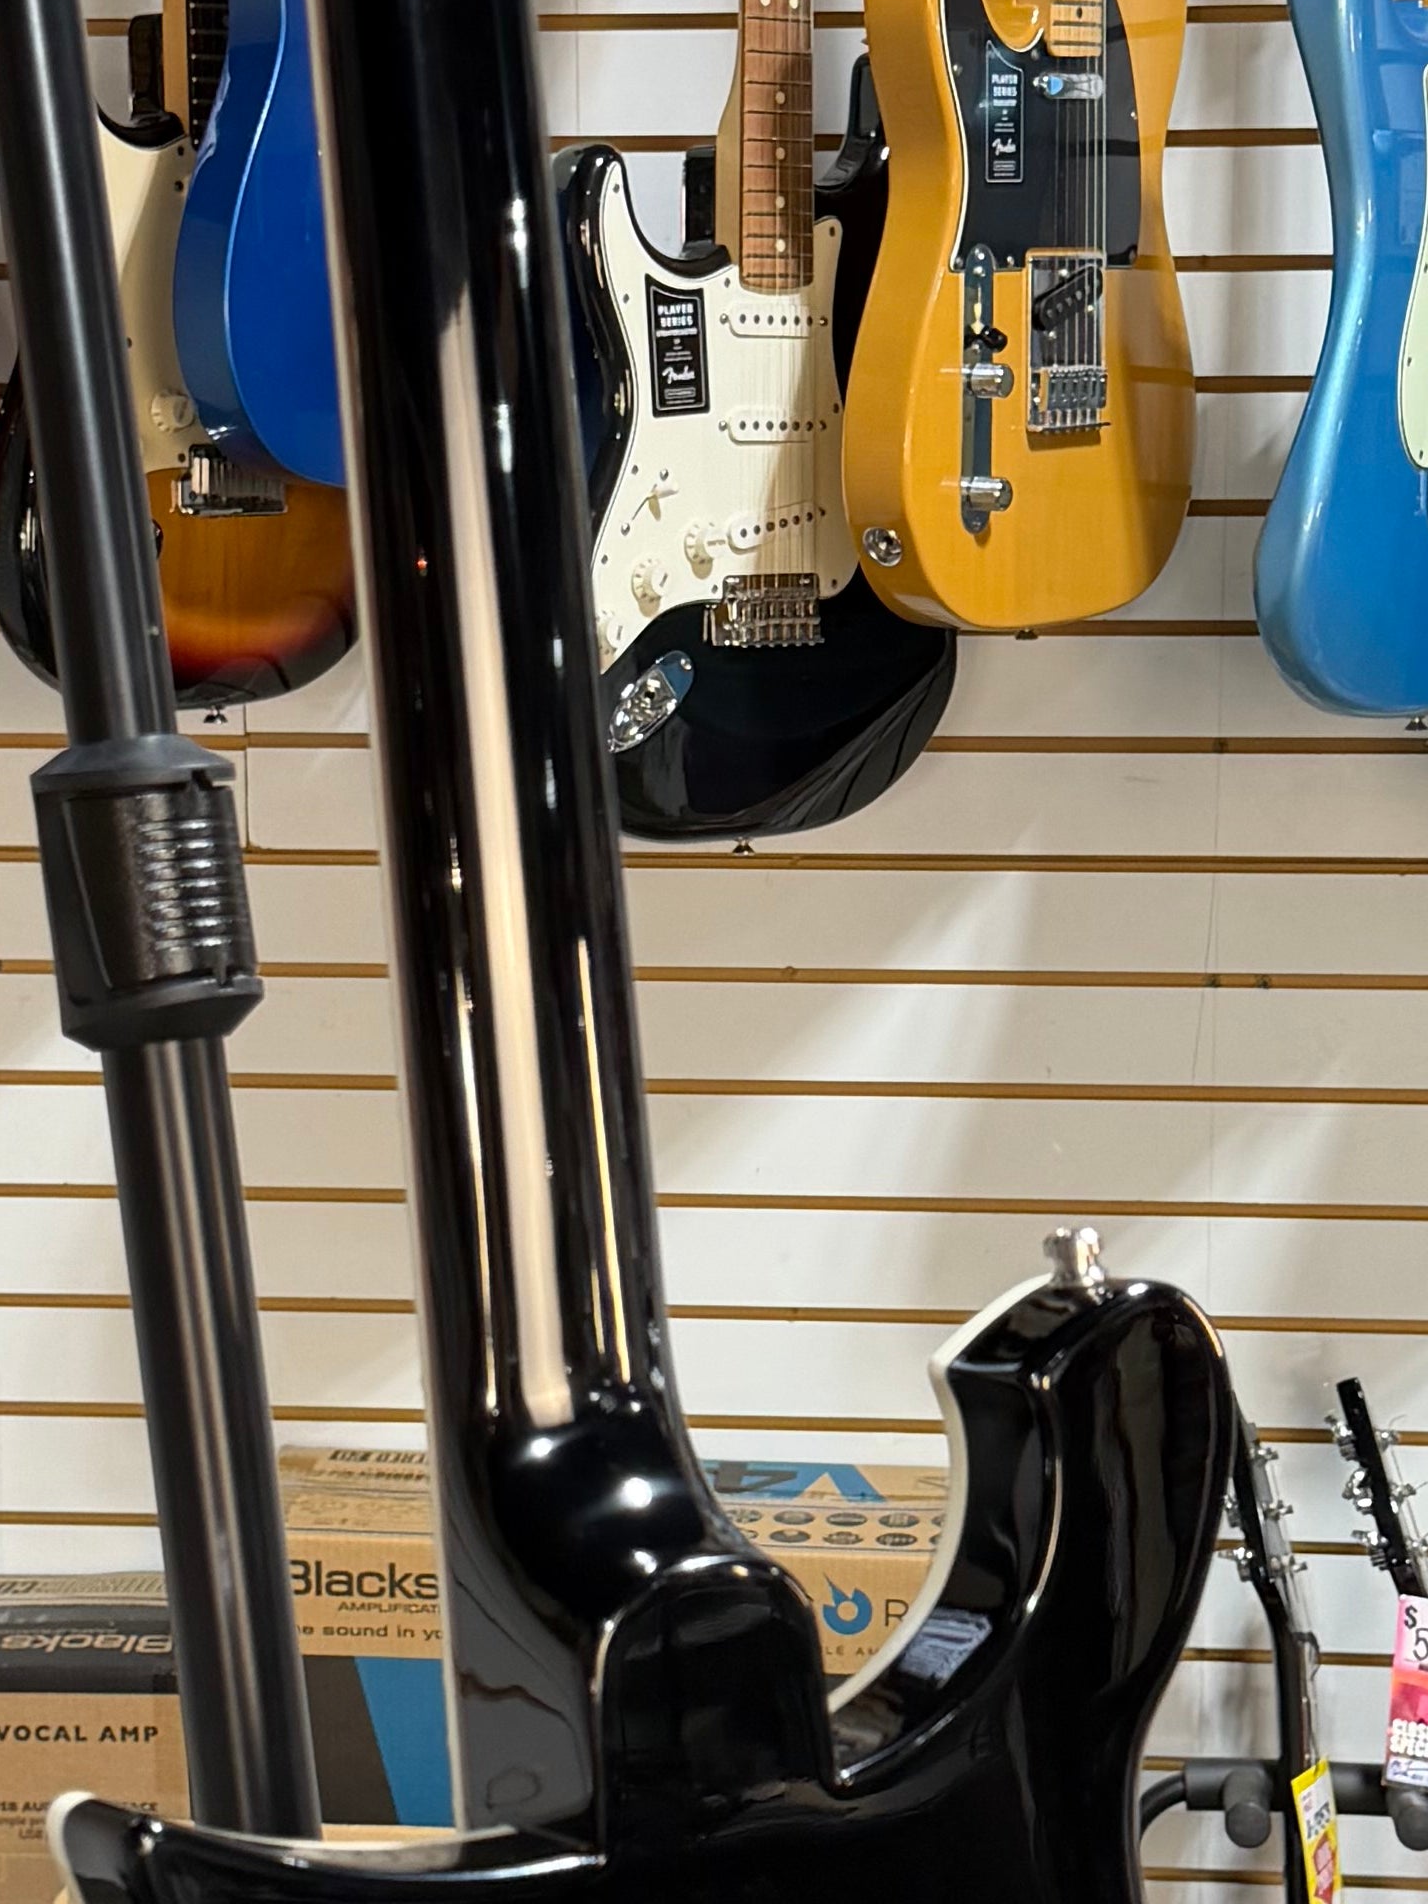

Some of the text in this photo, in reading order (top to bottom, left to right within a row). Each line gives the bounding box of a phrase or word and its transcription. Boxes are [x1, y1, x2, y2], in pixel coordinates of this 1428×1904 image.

[657, 303, 694, 317] PLAYER
[337, 1602, 439, 1615] AMPLIFICAT
[322, 1623, 418, 1640] sound in
[97, 1724, 160, 1745] AMP
